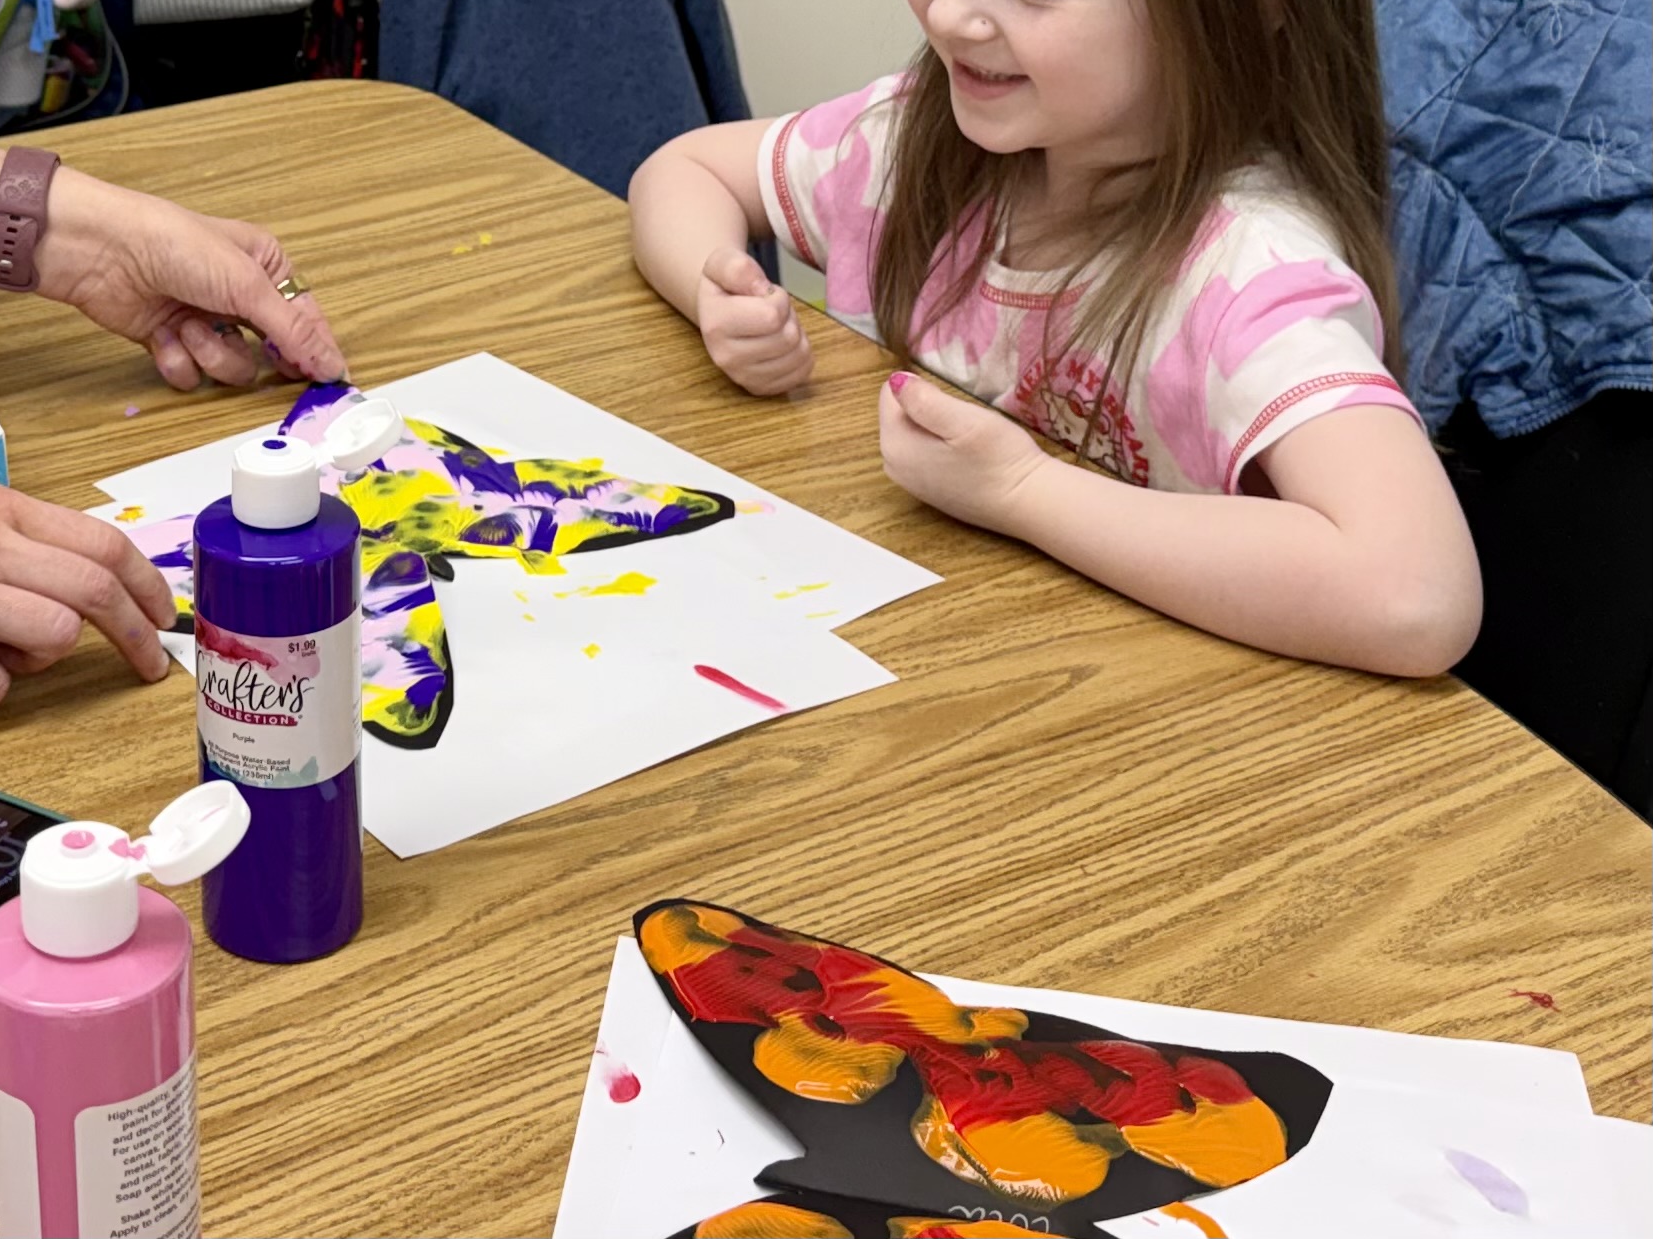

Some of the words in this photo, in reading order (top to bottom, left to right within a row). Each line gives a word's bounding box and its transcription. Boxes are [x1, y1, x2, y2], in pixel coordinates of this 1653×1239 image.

[288, 639, 316, 654] $1.99
[197, 649, 315, 714] Crafter's
[207, 699, 289, 725] COLLECTION
[232, 733, 255, 744] Purple
[123, 1114, 148, 1132] paint
[113, 1132, 133, 1145] and
[113, 1147, 129, 1156] For
[133, 1138, 150, 1150] use
[120, 1176, 139, 1190] and
[116, 1189, 142, 1203] Soap
[121, 1208, 150, 1224] Shake
[110, 1224, 139, 1239] Apply
[142, 1220, 152, 1228] to
